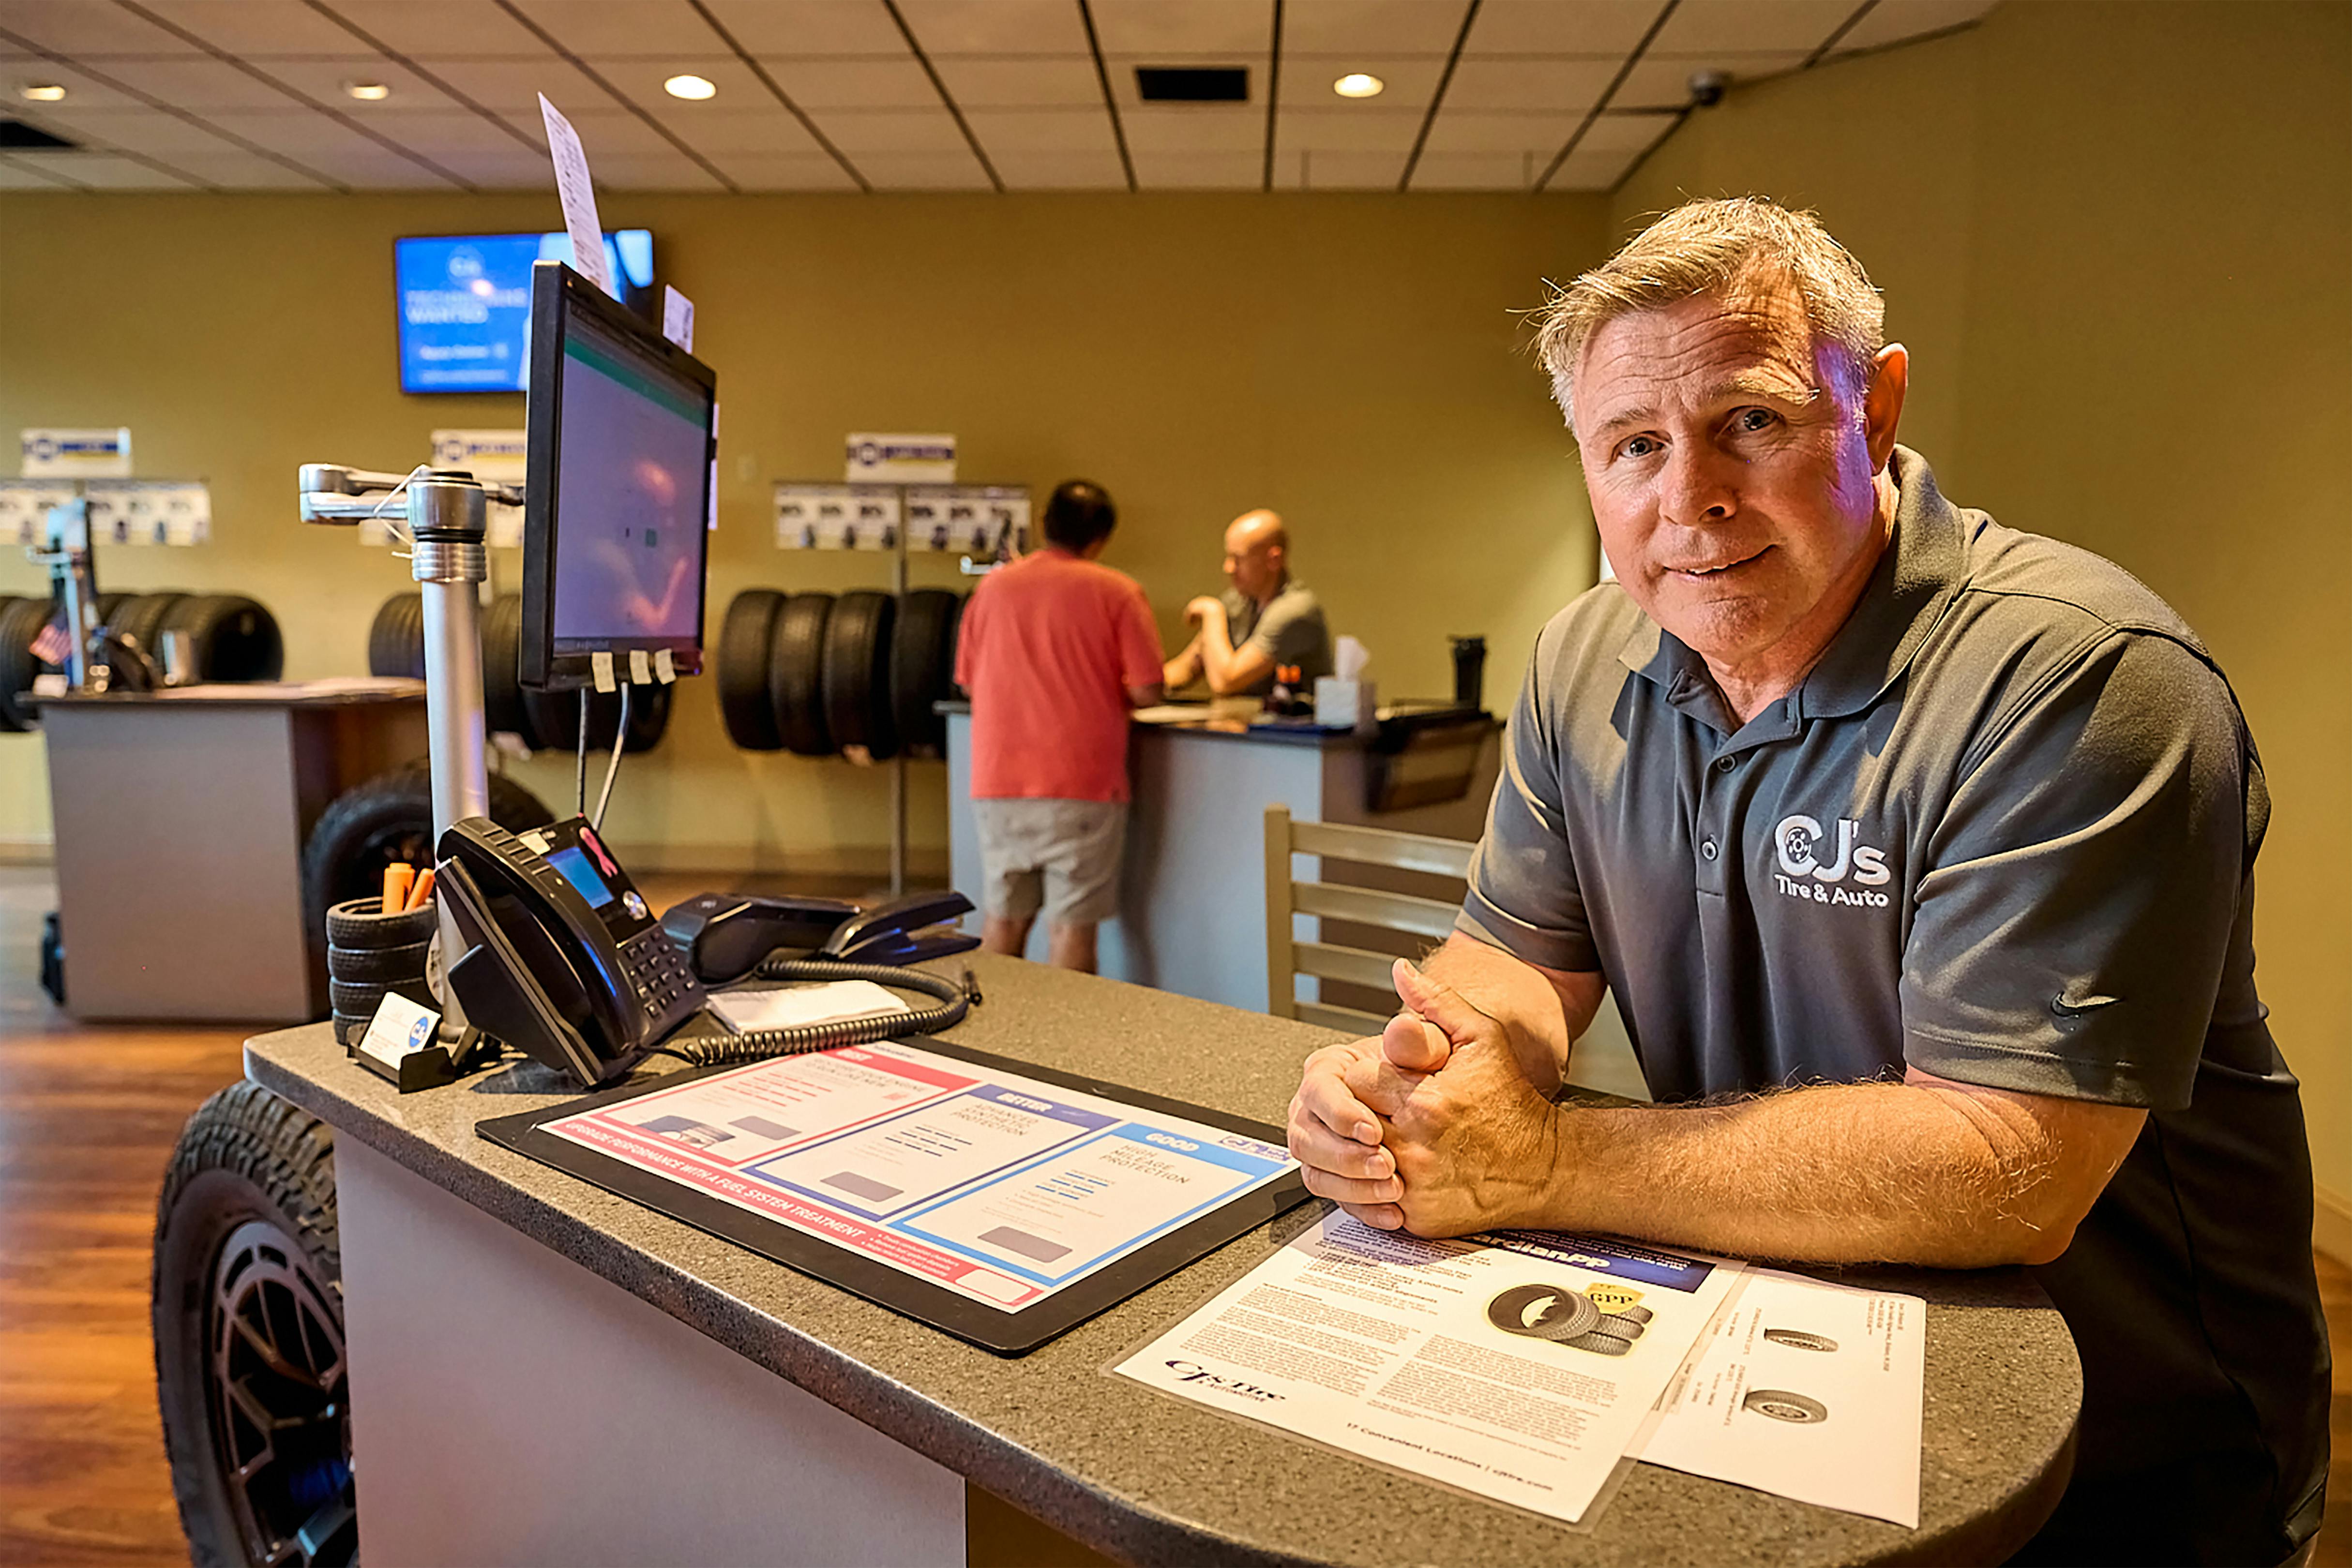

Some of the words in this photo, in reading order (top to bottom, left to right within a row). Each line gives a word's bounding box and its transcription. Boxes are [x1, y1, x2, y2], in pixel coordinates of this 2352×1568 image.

[1775, 815, 1891, 885] CJ's
[1774, 874, 1811, 898] Tire
[1813, 883, 1829, 903] &
[1831, 887, 1889, 907] Auto
[996, 1091, 1053, 1113] BETTER
[948, 1111, 1029, 1135] PROTECTION
[1120, 1145, 1159, 1157] HIGH
[1146, 1132, 1200, 1153] GOOD
[1097, 1154, 1192, 1183] PROTECTION
[1109, 1150, 1176, 1170] MILEAGE
[565, 1122, 614, 1141] UPGRADE
[613, 1139, 683, 1169] PERFORMANCE
[680, 1165, 709, 1181] WITH
[718, 1178, 747, 1193] FUEL
[746, 1190, 791, 1210] SYSTEM
[792, 1207, 866, 1238] TREATMENT
[1590, 1292, 1632, 1304] GPP
[1361, 1428, 1423, 1450] Convenient
[1426, 1448, 1481, 1468] Locations
